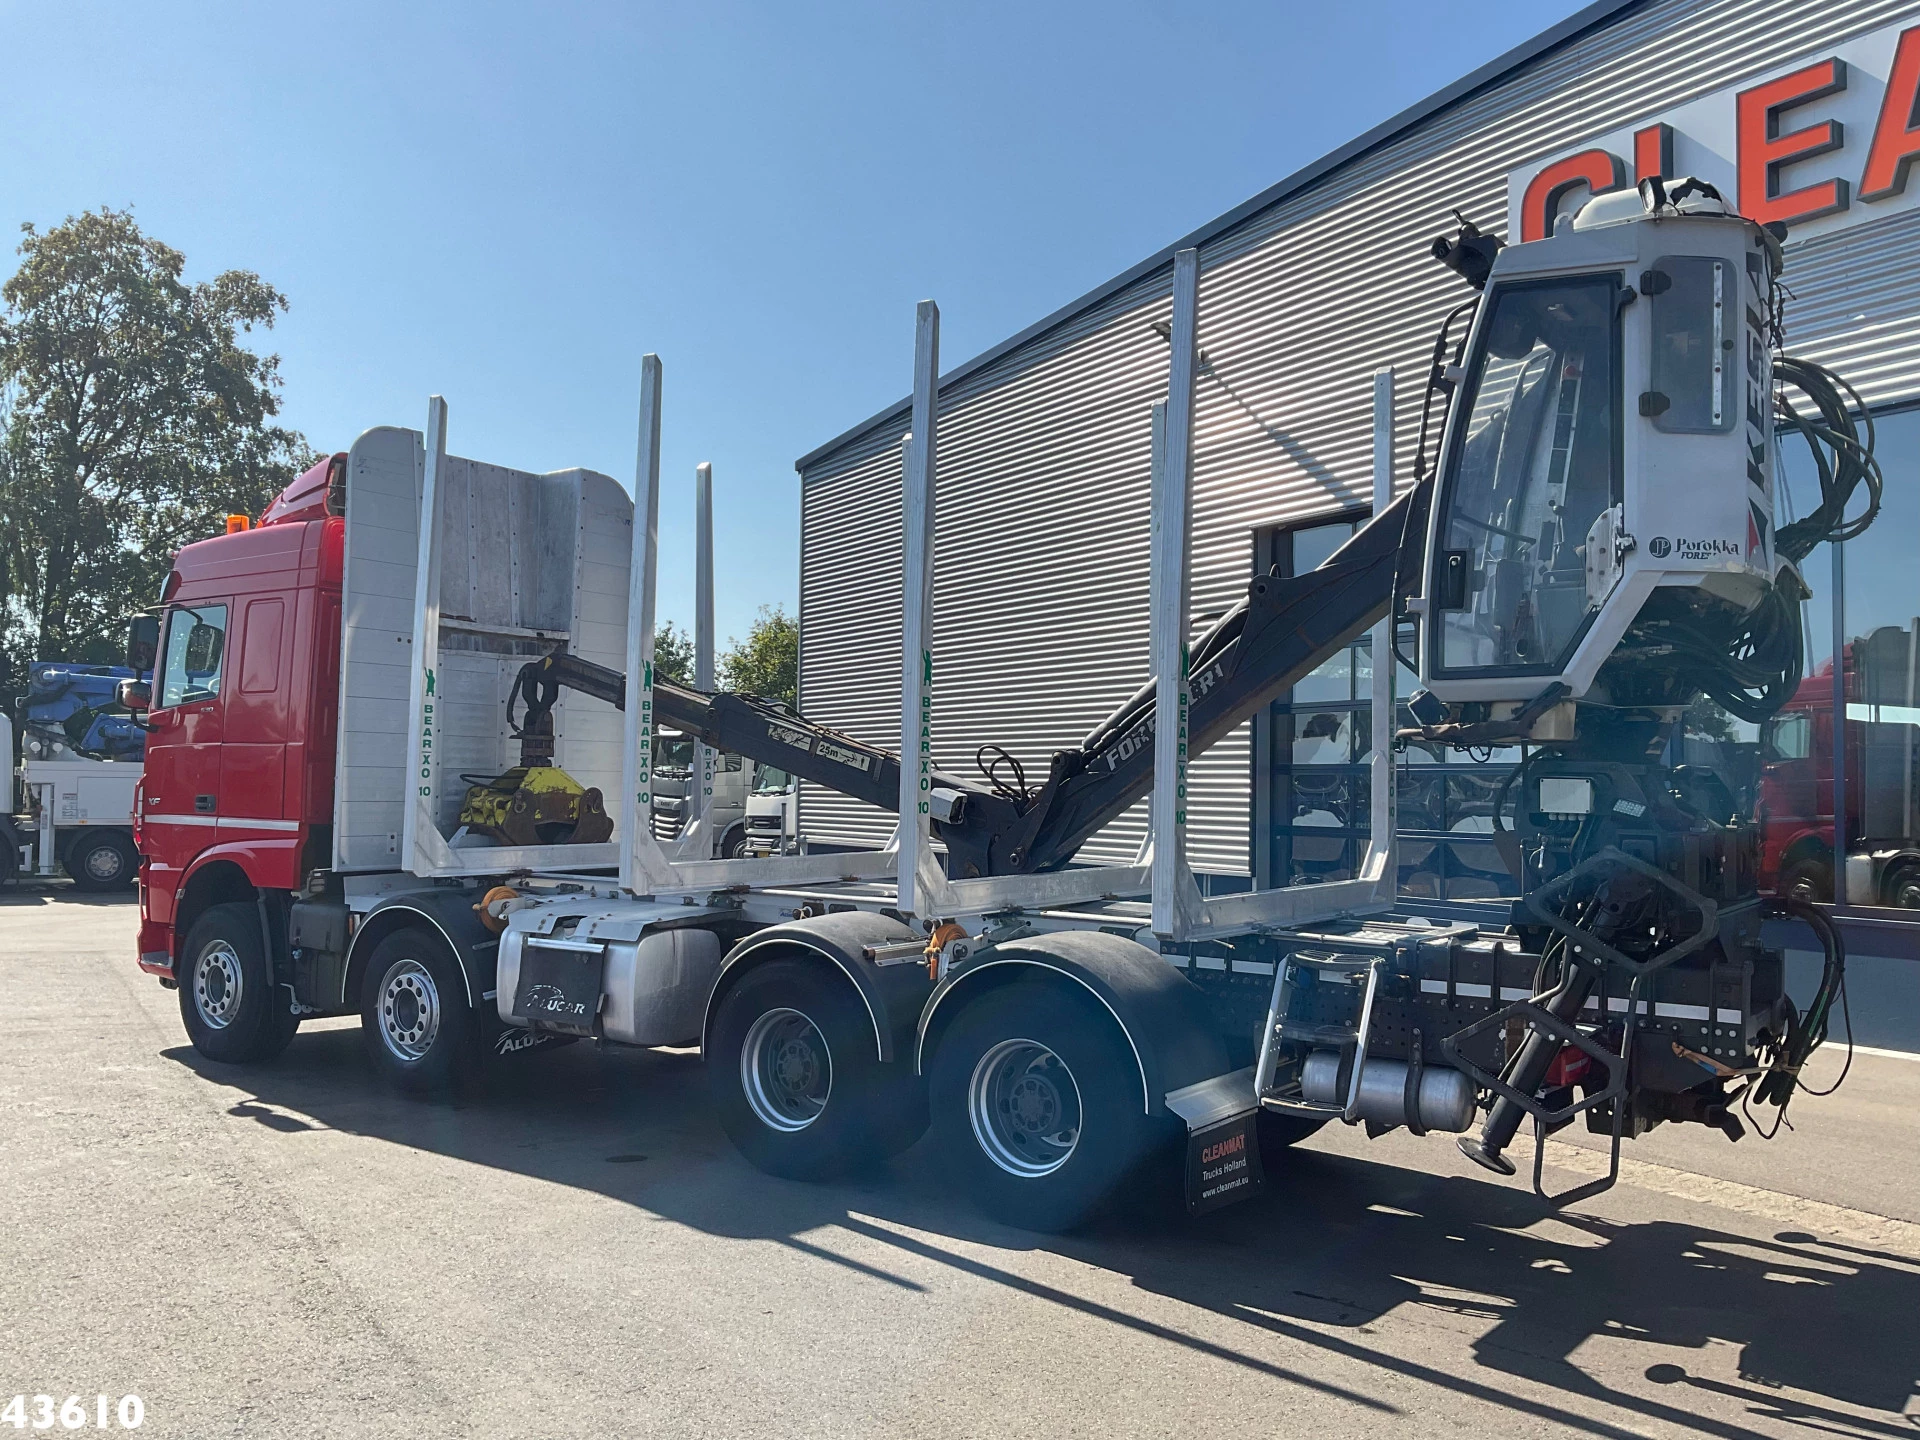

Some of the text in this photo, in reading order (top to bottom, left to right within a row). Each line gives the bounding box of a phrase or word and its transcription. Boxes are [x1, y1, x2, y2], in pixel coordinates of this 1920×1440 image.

[1674, 538, 1739, 555] Porokka
[819, 744, 839, 758] 25m
[418, 786, 431, 797] 10
[637, 792, 650, 804] 10
[703, 787, 713, 796] 10
[917, 801, 929, 814] 10
[1175, 811, 1186, 825] 10
[1203, 1134, 1245, 1163] CLEANMAT
[1203, 1157, 1246, 1180] Trucks Holland
[1203, 1177, 1248, 1198] www.cleanmat.eu
